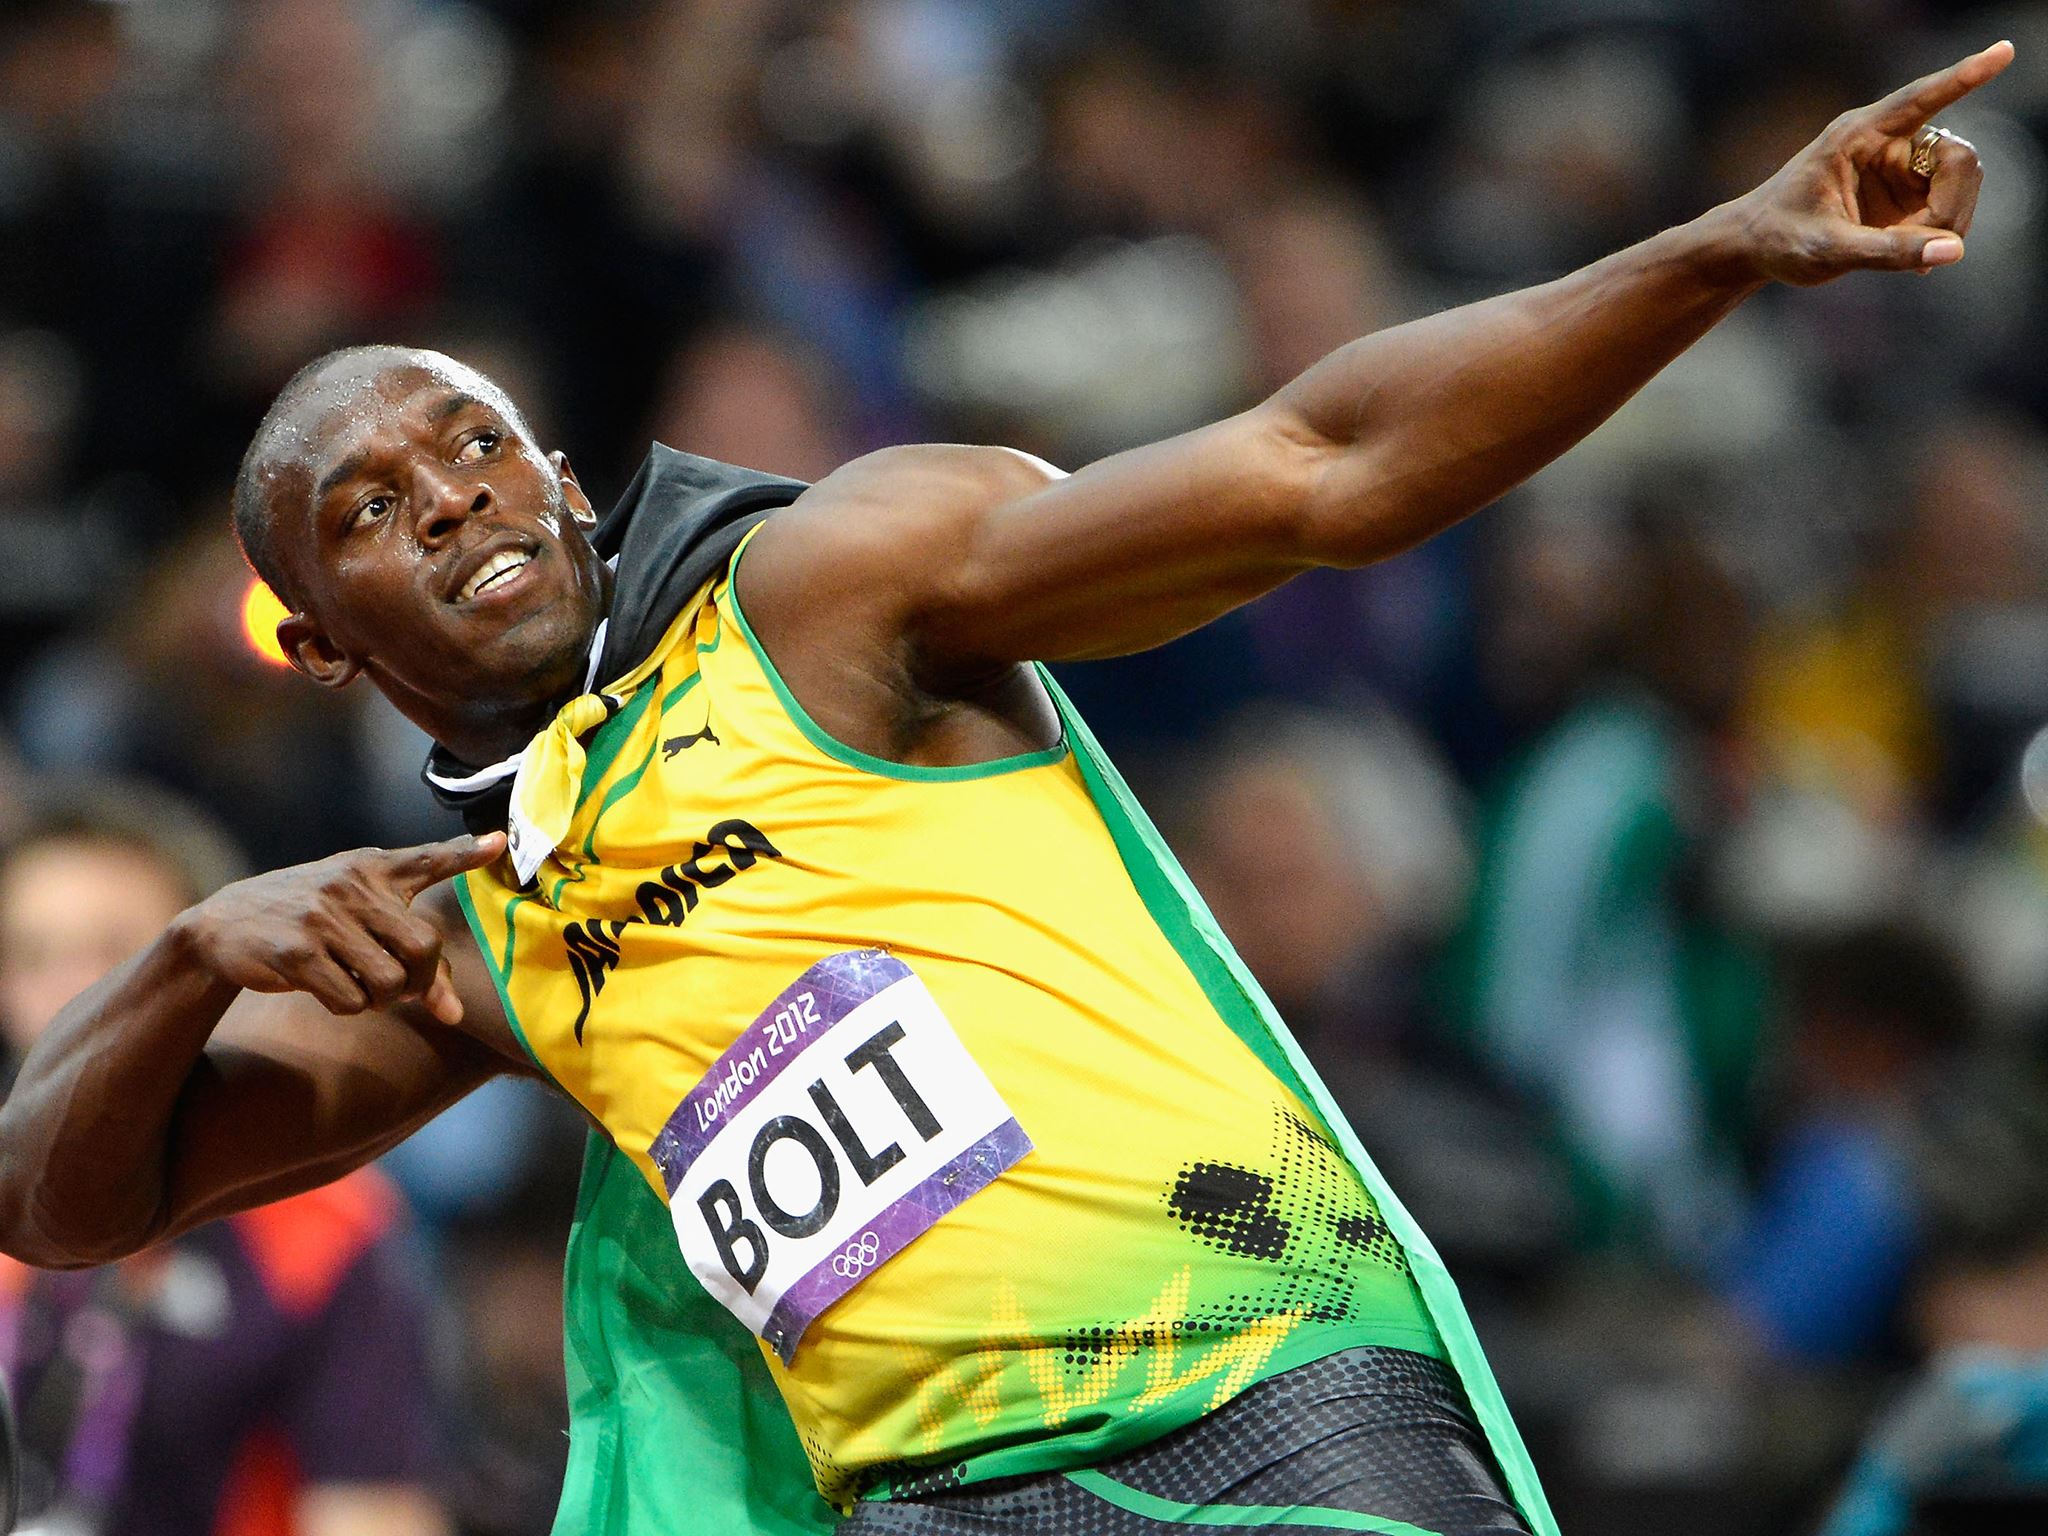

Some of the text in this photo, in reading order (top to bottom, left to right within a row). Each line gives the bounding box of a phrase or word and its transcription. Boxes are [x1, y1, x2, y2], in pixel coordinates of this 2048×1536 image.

[694, 991, 822, 1133] London 2012
[696, 1020, 944, 1297] BOLT
